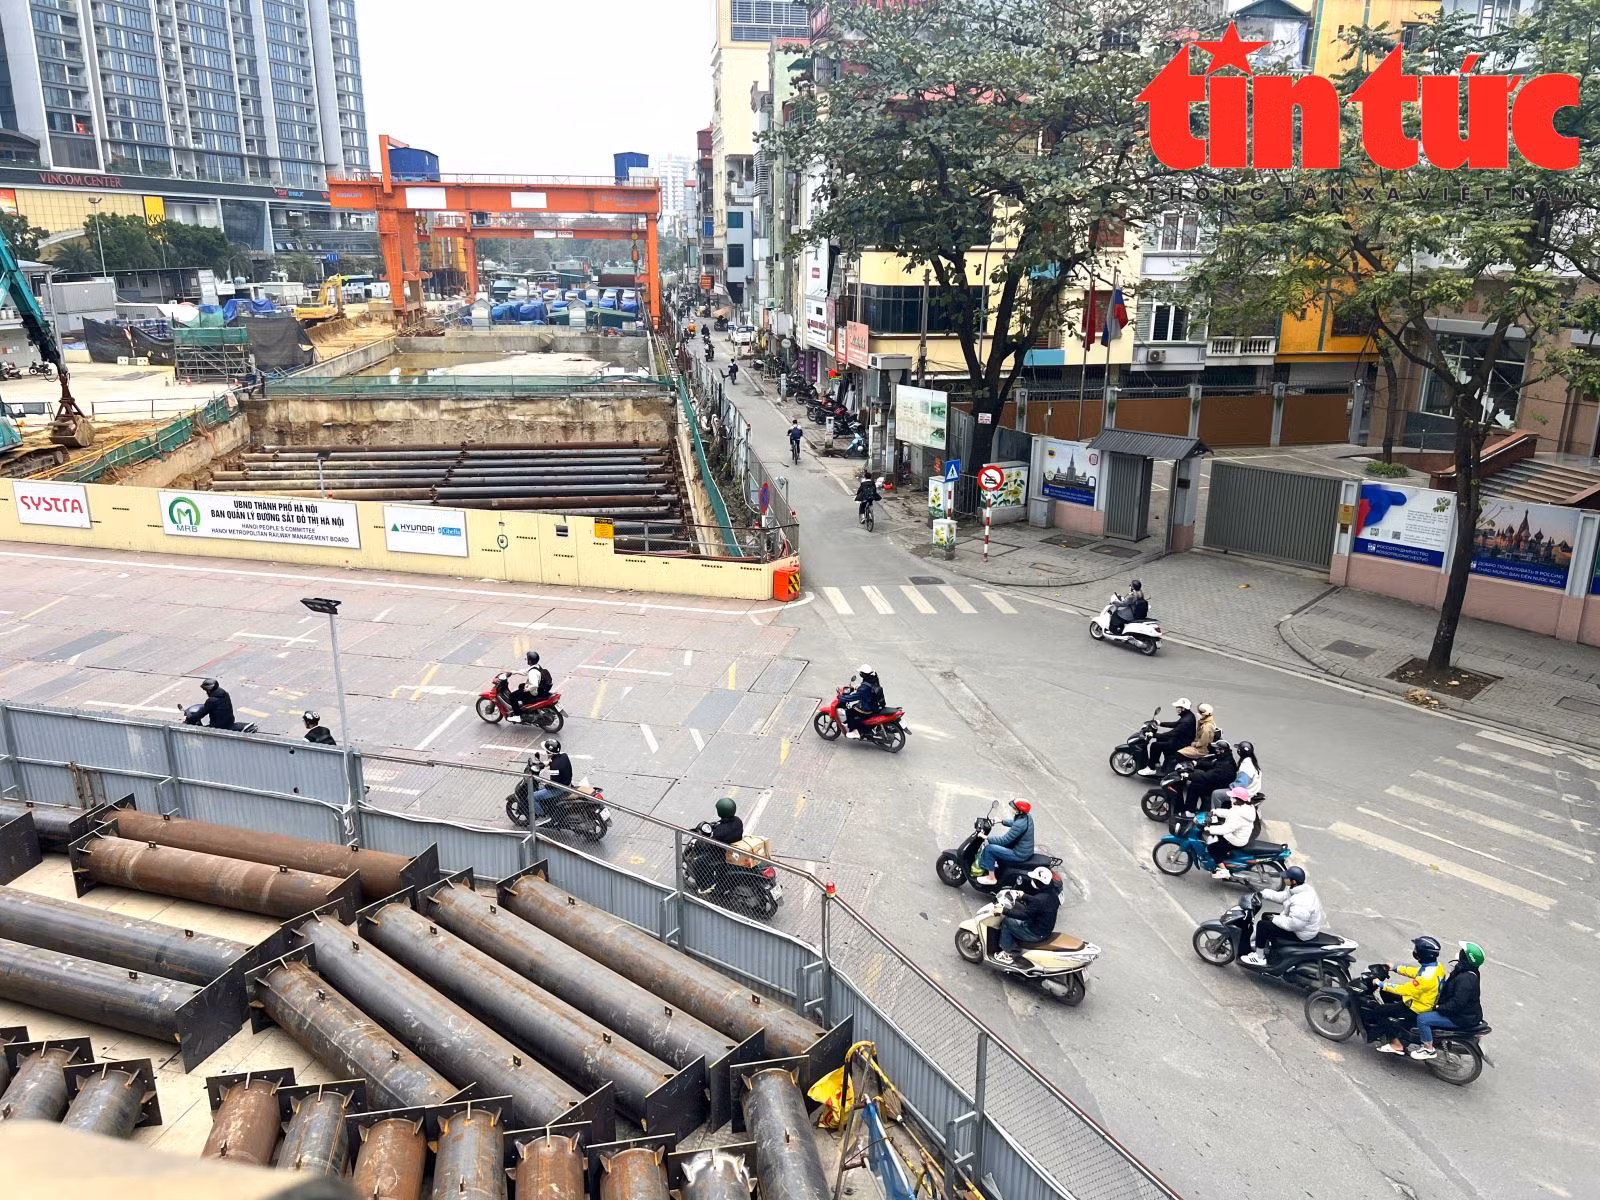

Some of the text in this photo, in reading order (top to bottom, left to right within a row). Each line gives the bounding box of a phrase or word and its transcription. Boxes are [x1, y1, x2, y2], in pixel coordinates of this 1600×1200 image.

[38, 173, 121, 188] VINCOM CENTER
[20, 496, 83, 513] SYSTRA
[233, 500, 318, 516] UBND THÀNH PHỐ HÀ NỘI
[210, 509, 345, 529] BAN QUẢN LÝ ĐƯỜNG SẮT ĐÔ THỊ HÀ NỘI
[176, 524, 198, 533] MRB
[285, 526, 316, 534] COMMITTEE
[400, 523, 435, 533] HYUNDAI
